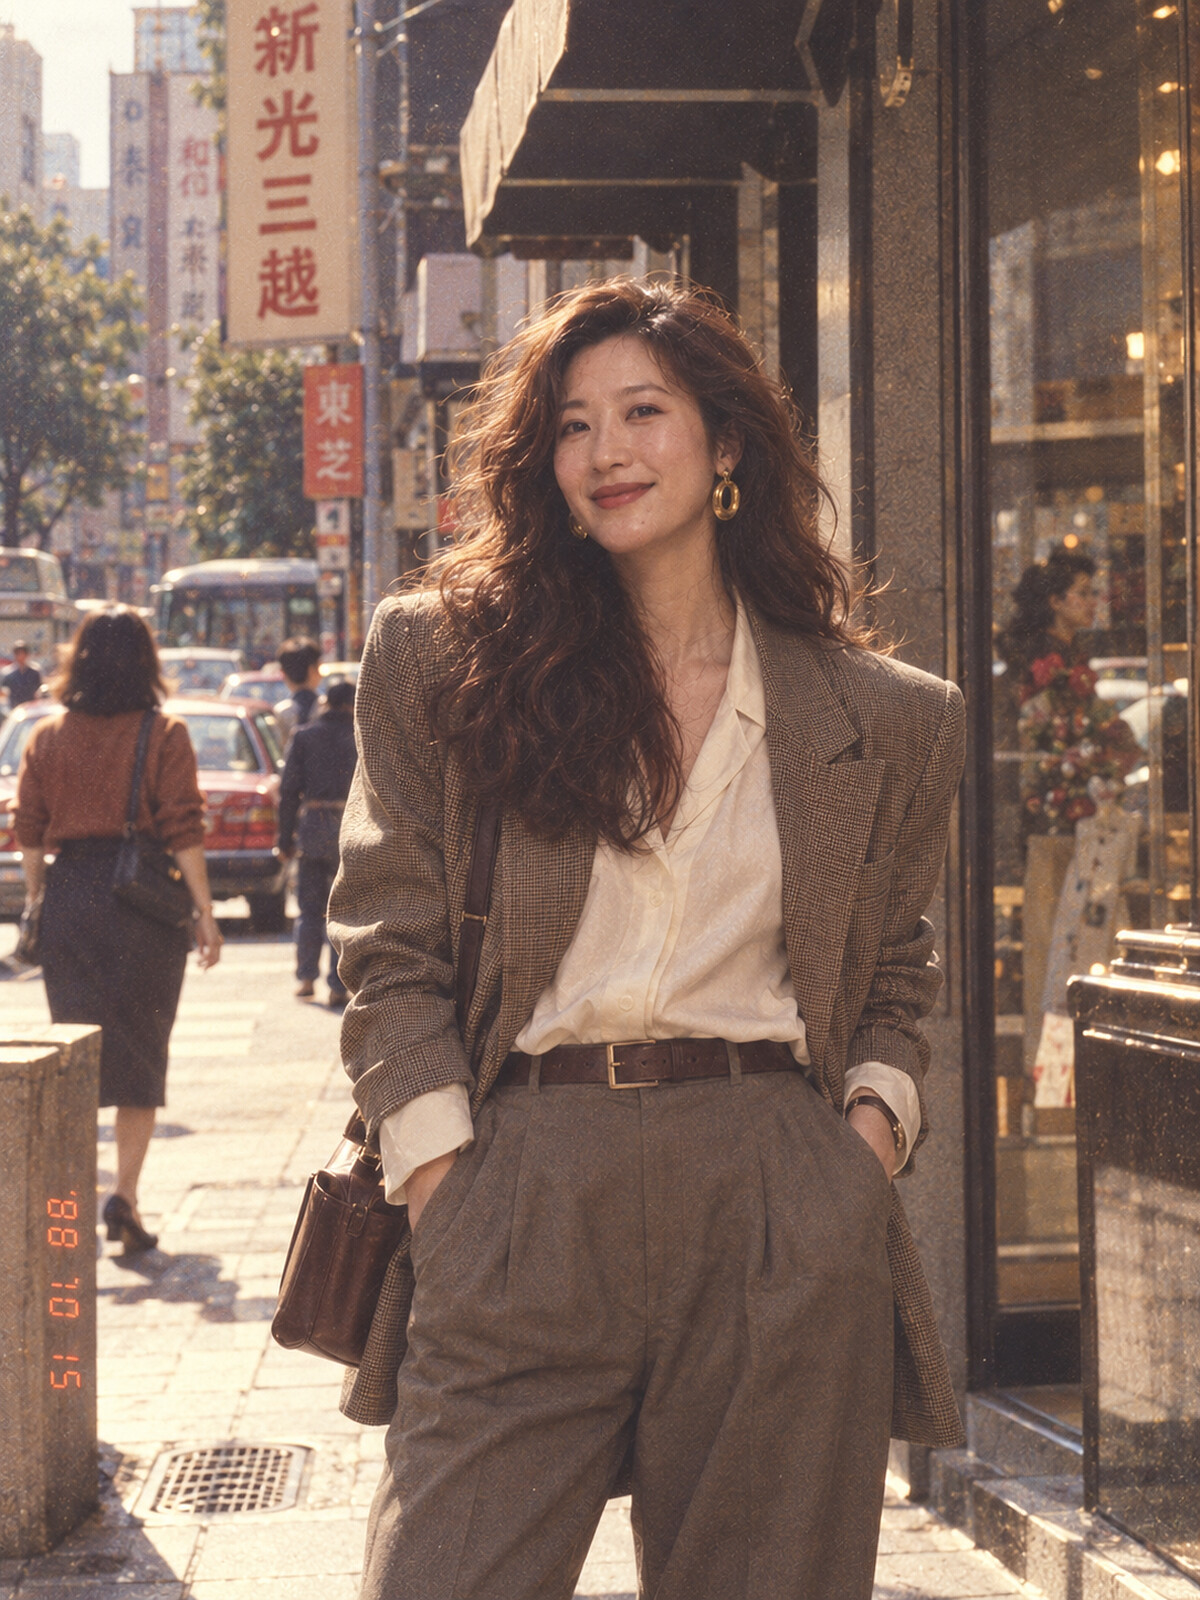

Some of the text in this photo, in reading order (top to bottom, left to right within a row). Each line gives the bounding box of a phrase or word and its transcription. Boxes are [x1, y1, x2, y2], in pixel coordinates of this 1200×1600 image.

[255, 2, 320, 320] 新光三越
[315, 379, 354, 480] 東芝
